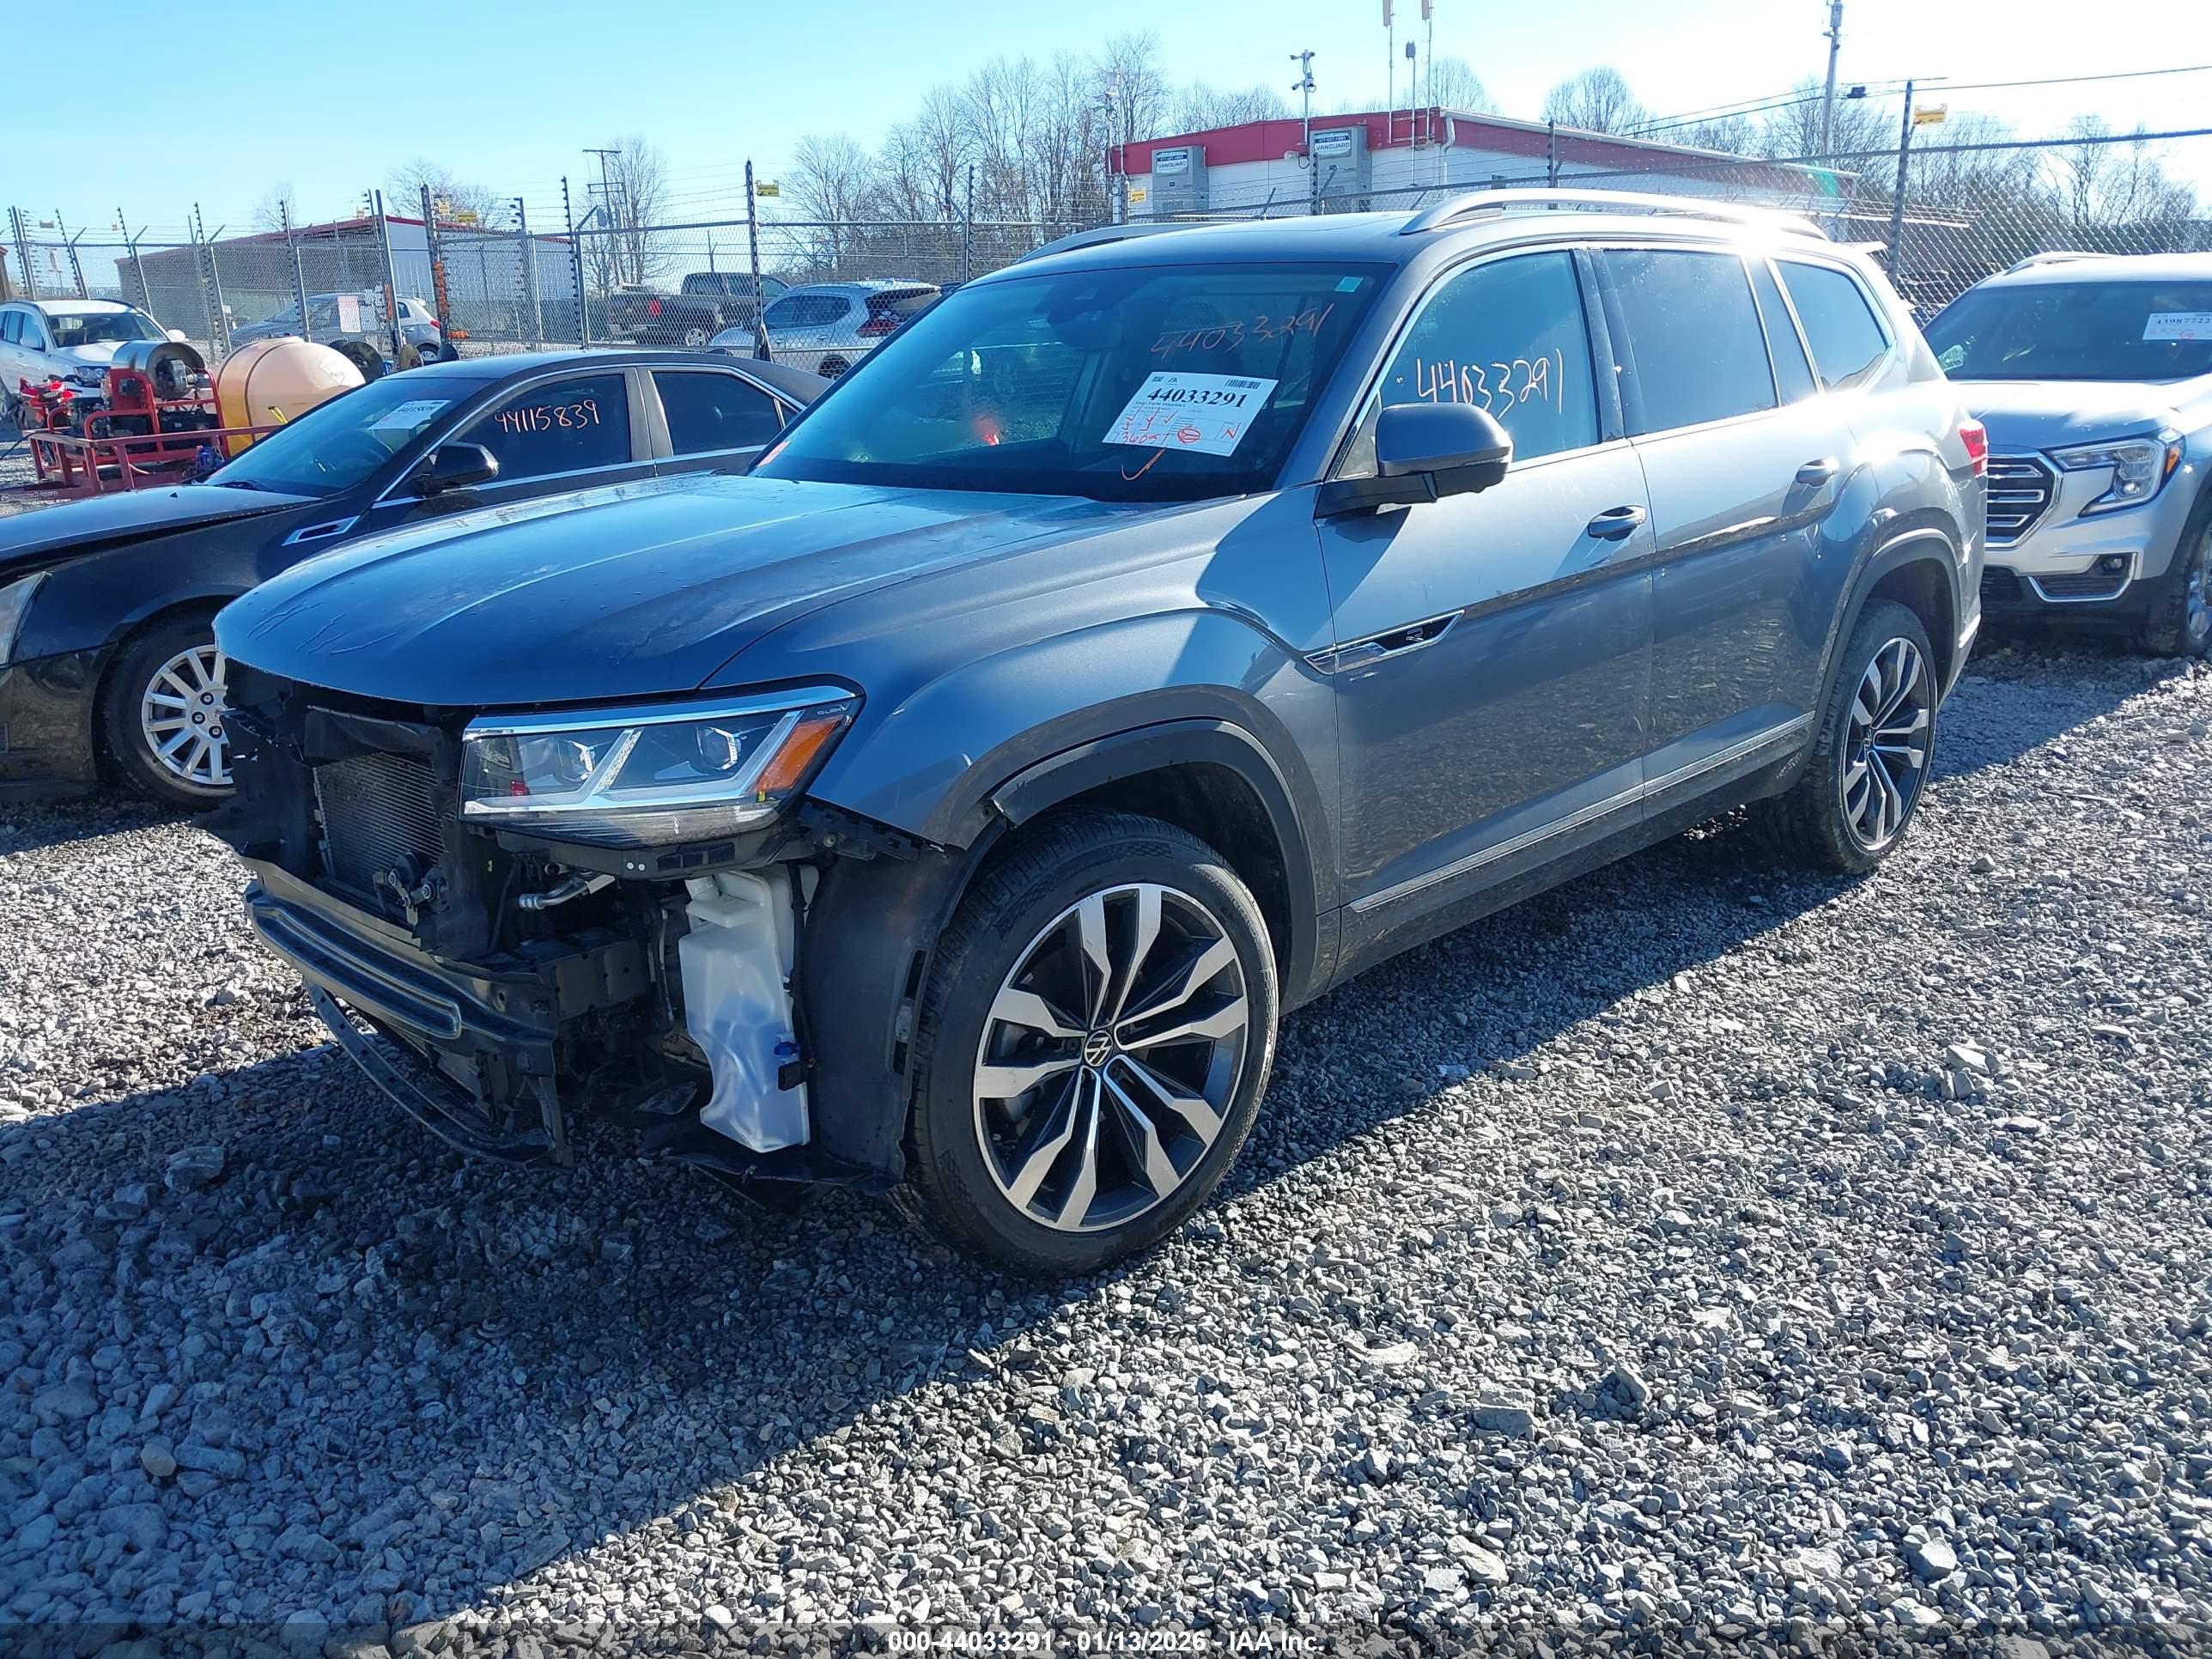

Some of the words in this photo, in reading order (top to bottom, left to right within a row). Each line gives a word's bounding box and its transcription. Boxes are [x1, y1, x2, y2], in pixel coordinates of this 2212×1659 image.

[1151, 302, 1334, 360] 44033291
[1146, 387, 1248, 408] 44033291
[1417, 348, 1563, 420] 44033291
[495, 399, 600, 434] 44115839
